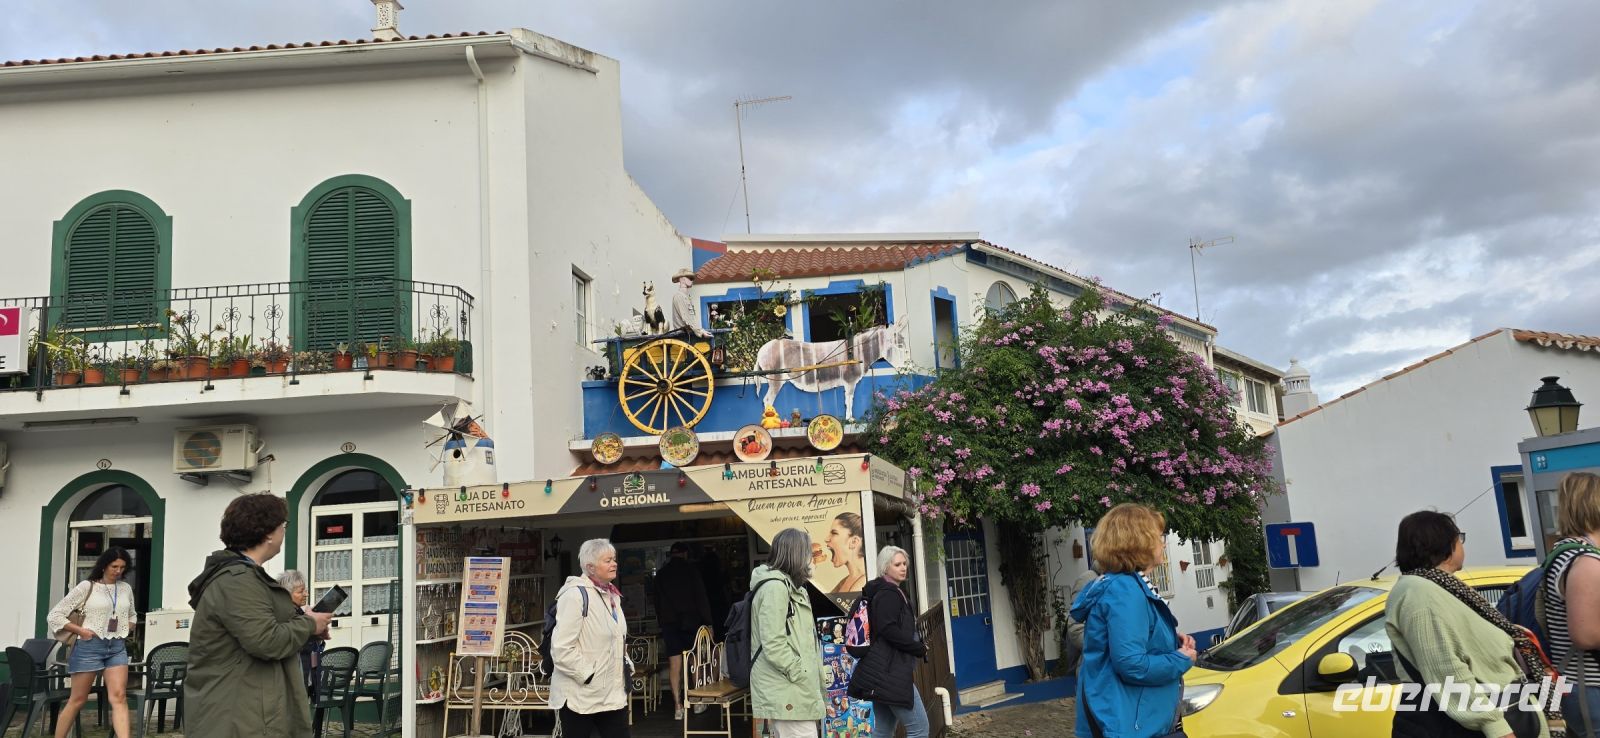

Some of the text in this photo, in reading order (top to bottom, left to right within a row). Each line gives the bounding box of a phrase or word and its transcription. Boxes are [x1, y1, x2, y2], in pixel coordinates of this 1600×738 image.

[748, 477, 817, 491] ARTESANAL
[454, 490, 496, 502] LJA DE
[611, 493, 670, 507] REGIONAL
[454, 499, 525, 514] ARTESANATO
[747, 498, 775, 513] Quem
[808, 494, 849, 509] Aprova!
